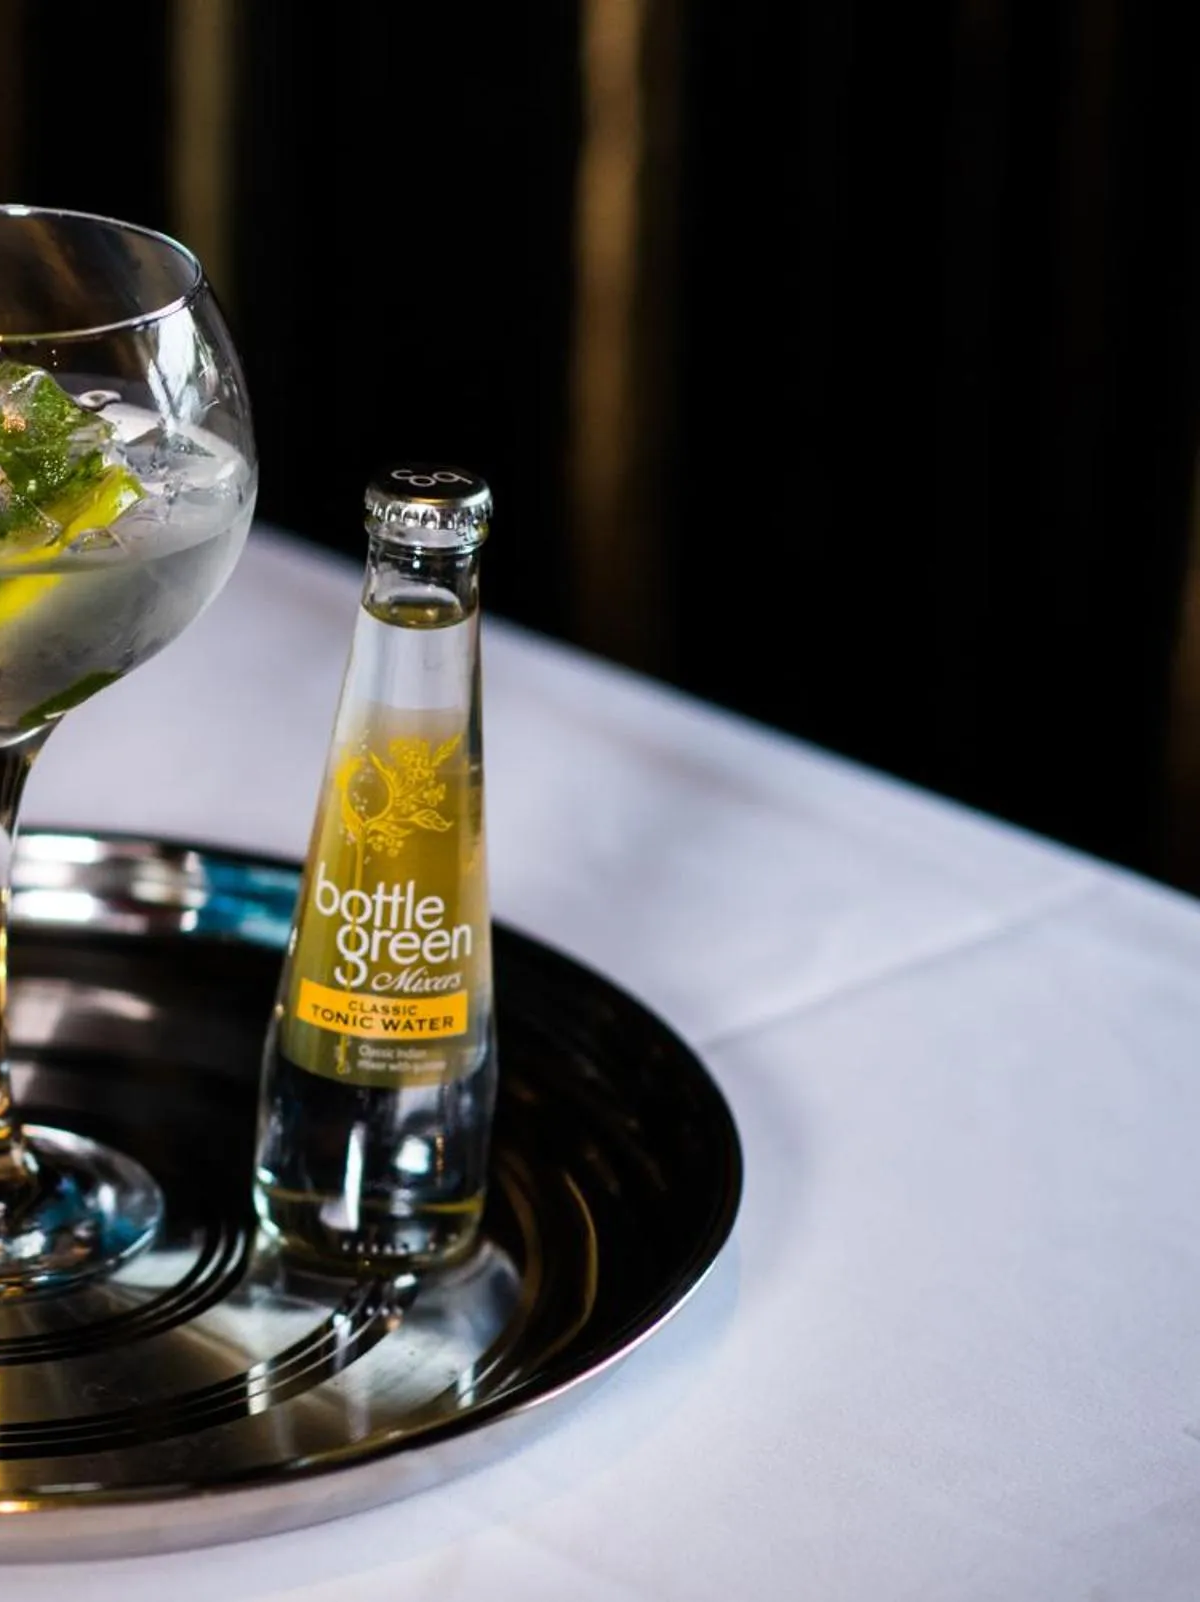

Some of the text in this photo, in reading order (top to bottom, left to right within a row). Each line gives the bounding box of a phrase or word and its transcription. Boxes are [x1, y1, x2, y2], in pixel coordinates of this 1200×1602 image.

[315, 861, 445, 930] bottle
[334, 924, 472, 988] green
[371, 966, 462, 993] Mixers
[310, 1004, 455, 1032] TONIC WATER
[348, 1000, 418, 1016] CLASSIC
